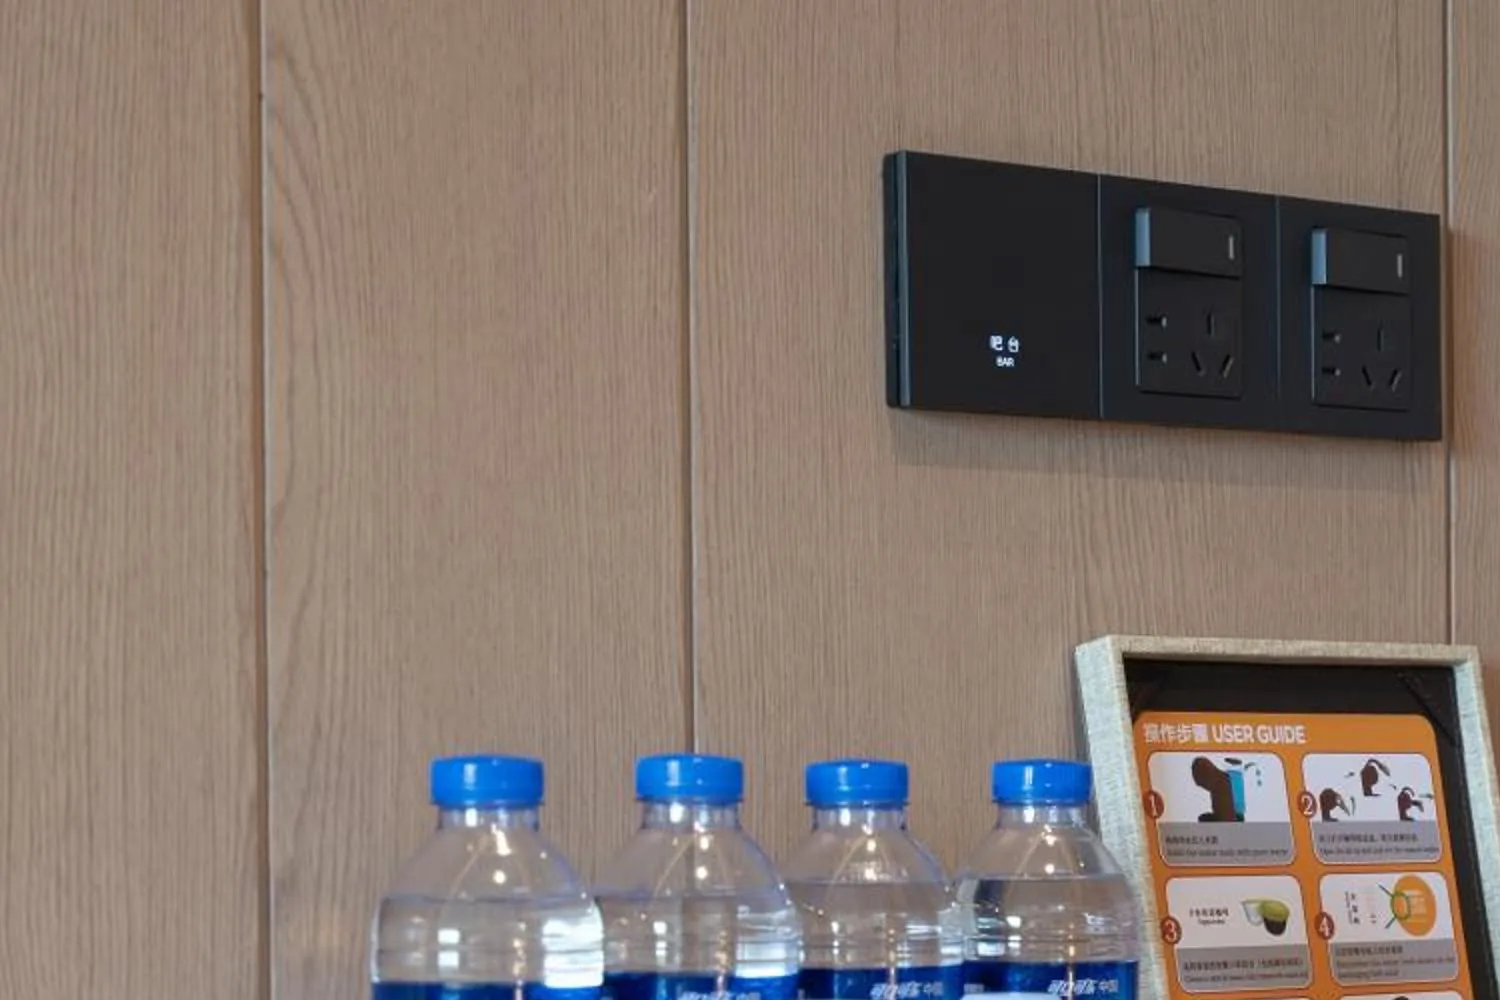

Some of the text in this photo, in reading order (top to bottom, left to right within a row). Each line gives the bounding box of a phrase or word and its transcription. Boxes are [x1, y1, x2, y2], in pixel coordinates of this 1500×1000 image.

[996, 356, 1015, 367] BAR
[1212, 724, 1254, 743] USER
[1257, 725, 1307, 744] GUIDE
[1302, 795, 1313, 815] 2
[1165, 918, 1177, 942] 3
[1319, 916, 1330, 937] 4
